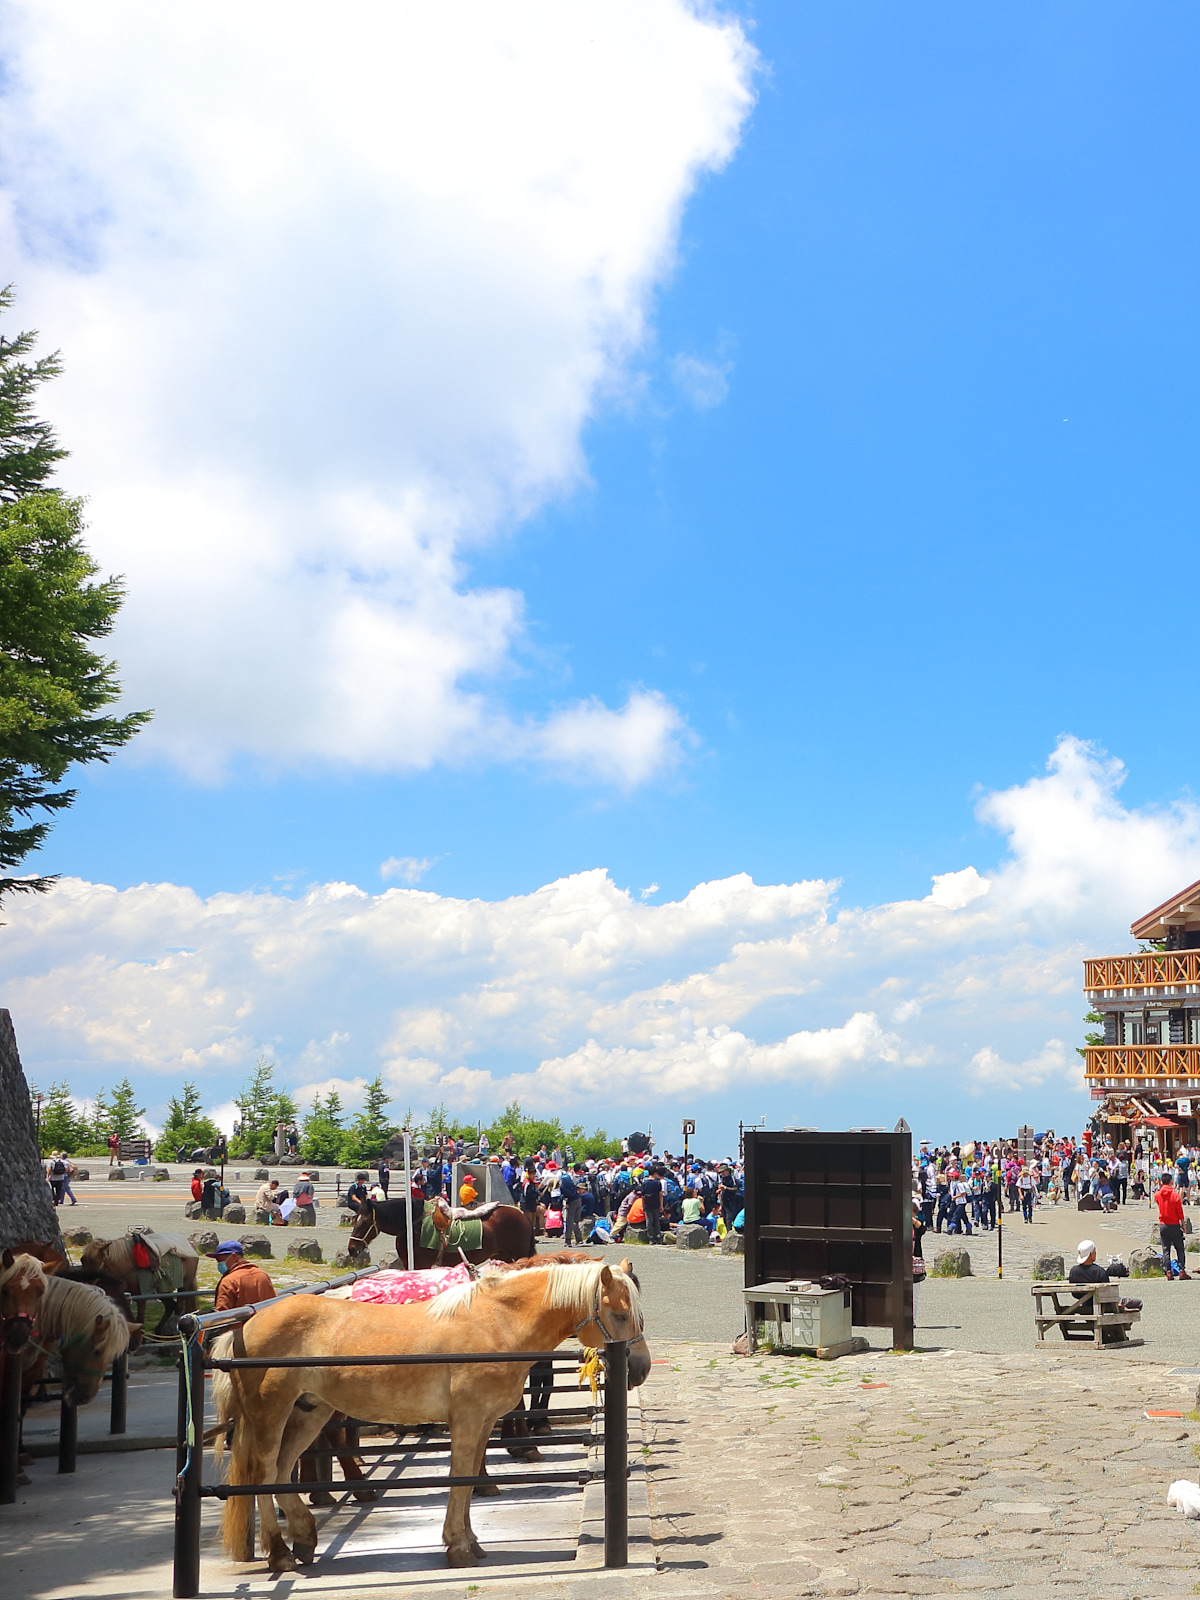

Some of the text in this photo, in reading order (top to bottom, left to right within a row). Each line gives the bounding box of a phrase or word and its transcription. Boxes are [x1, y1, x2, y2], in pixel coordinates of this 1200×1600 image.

[686, 1123, 693, 1133] D
[218, 1138, 224, 1146] F
[435, 1135, 440, 1145] E
[442, 1135, 447, 1145] E
[992, 1146, 999, 1158] C
[1001, 1146, 1006, 1158] C
